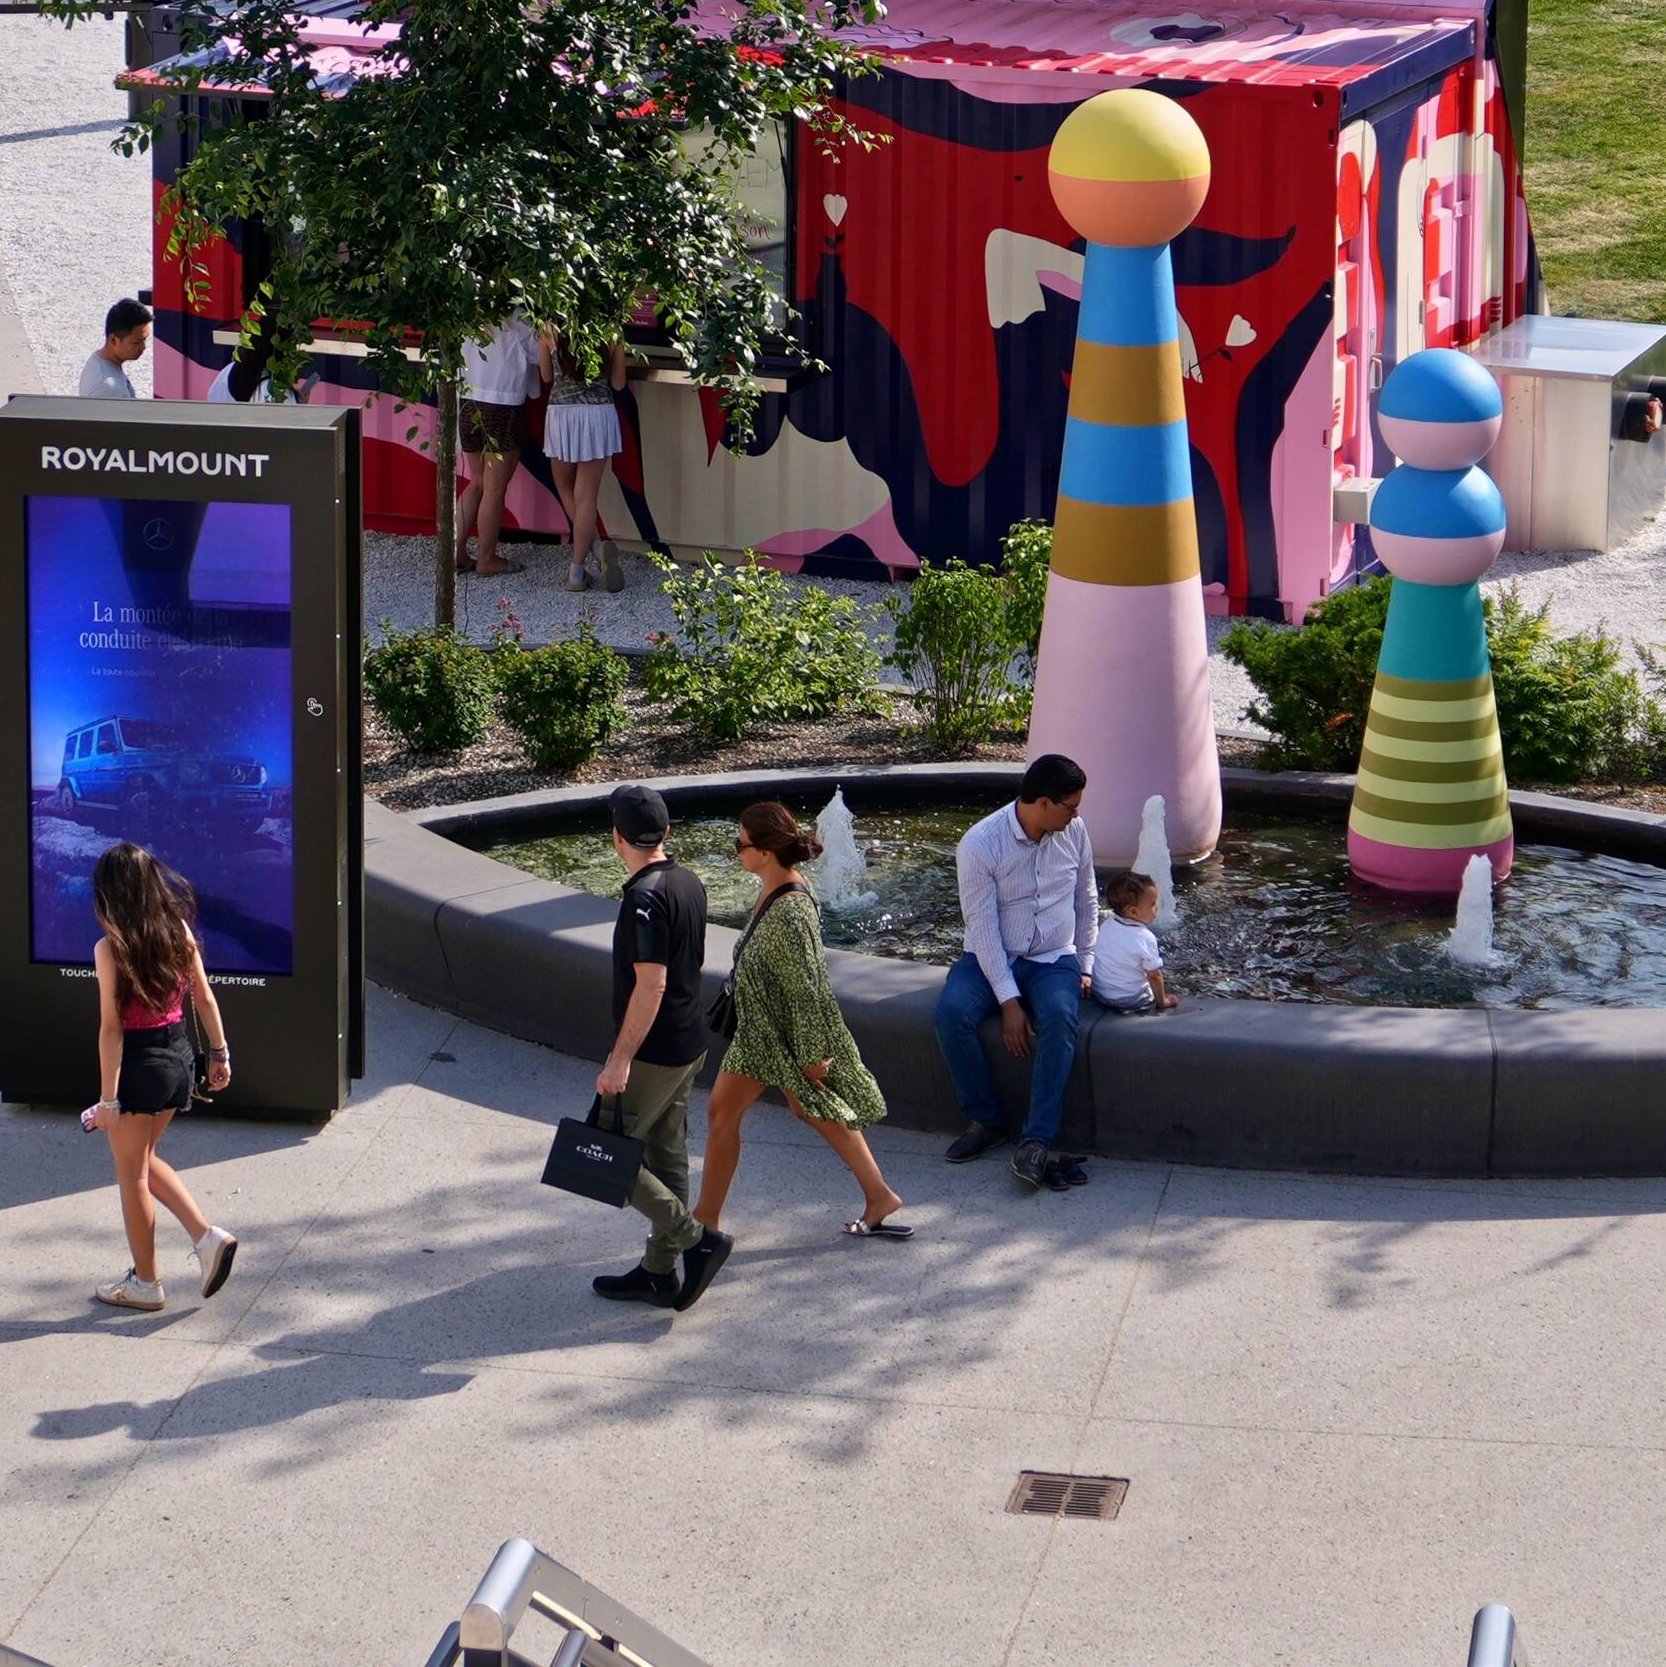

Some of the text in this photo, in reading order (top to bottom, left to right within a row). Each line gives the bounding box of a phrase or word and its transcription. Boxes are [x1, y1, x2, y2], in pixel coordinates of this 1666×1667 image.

[41, 446, 270, 478] ROYALMOUNT
[93, 601, 114, 623] La
[120, 602, 182, 626] montée
[79, 629, 152, 650] conduite
[59, 968, 267, 987] TOUCH ÉPERTOIRE
[575, 1145, 614, 1162] COACH
